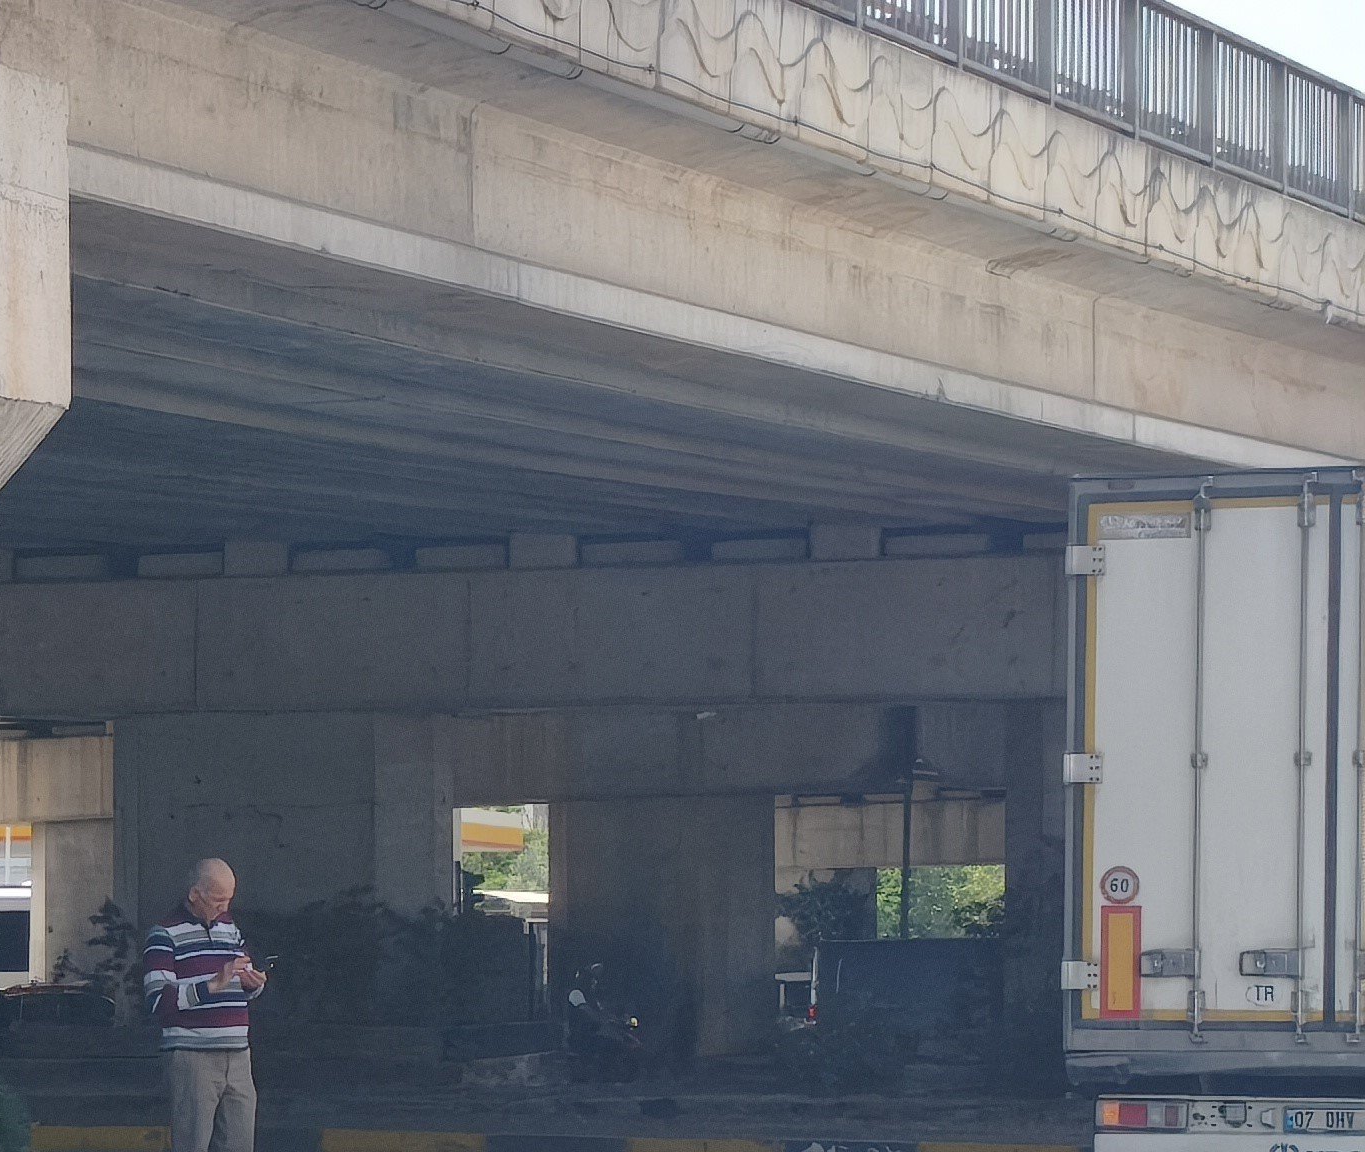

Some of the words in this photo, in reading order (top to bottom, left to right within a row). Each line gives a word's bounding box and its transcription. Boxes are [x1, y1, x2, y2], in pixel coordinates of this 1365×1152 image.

[1110, 878, 1129, 893] 60
[1254, 984, 1275, 1002] TR
[1295, 1111, 1315, 1129] 07
